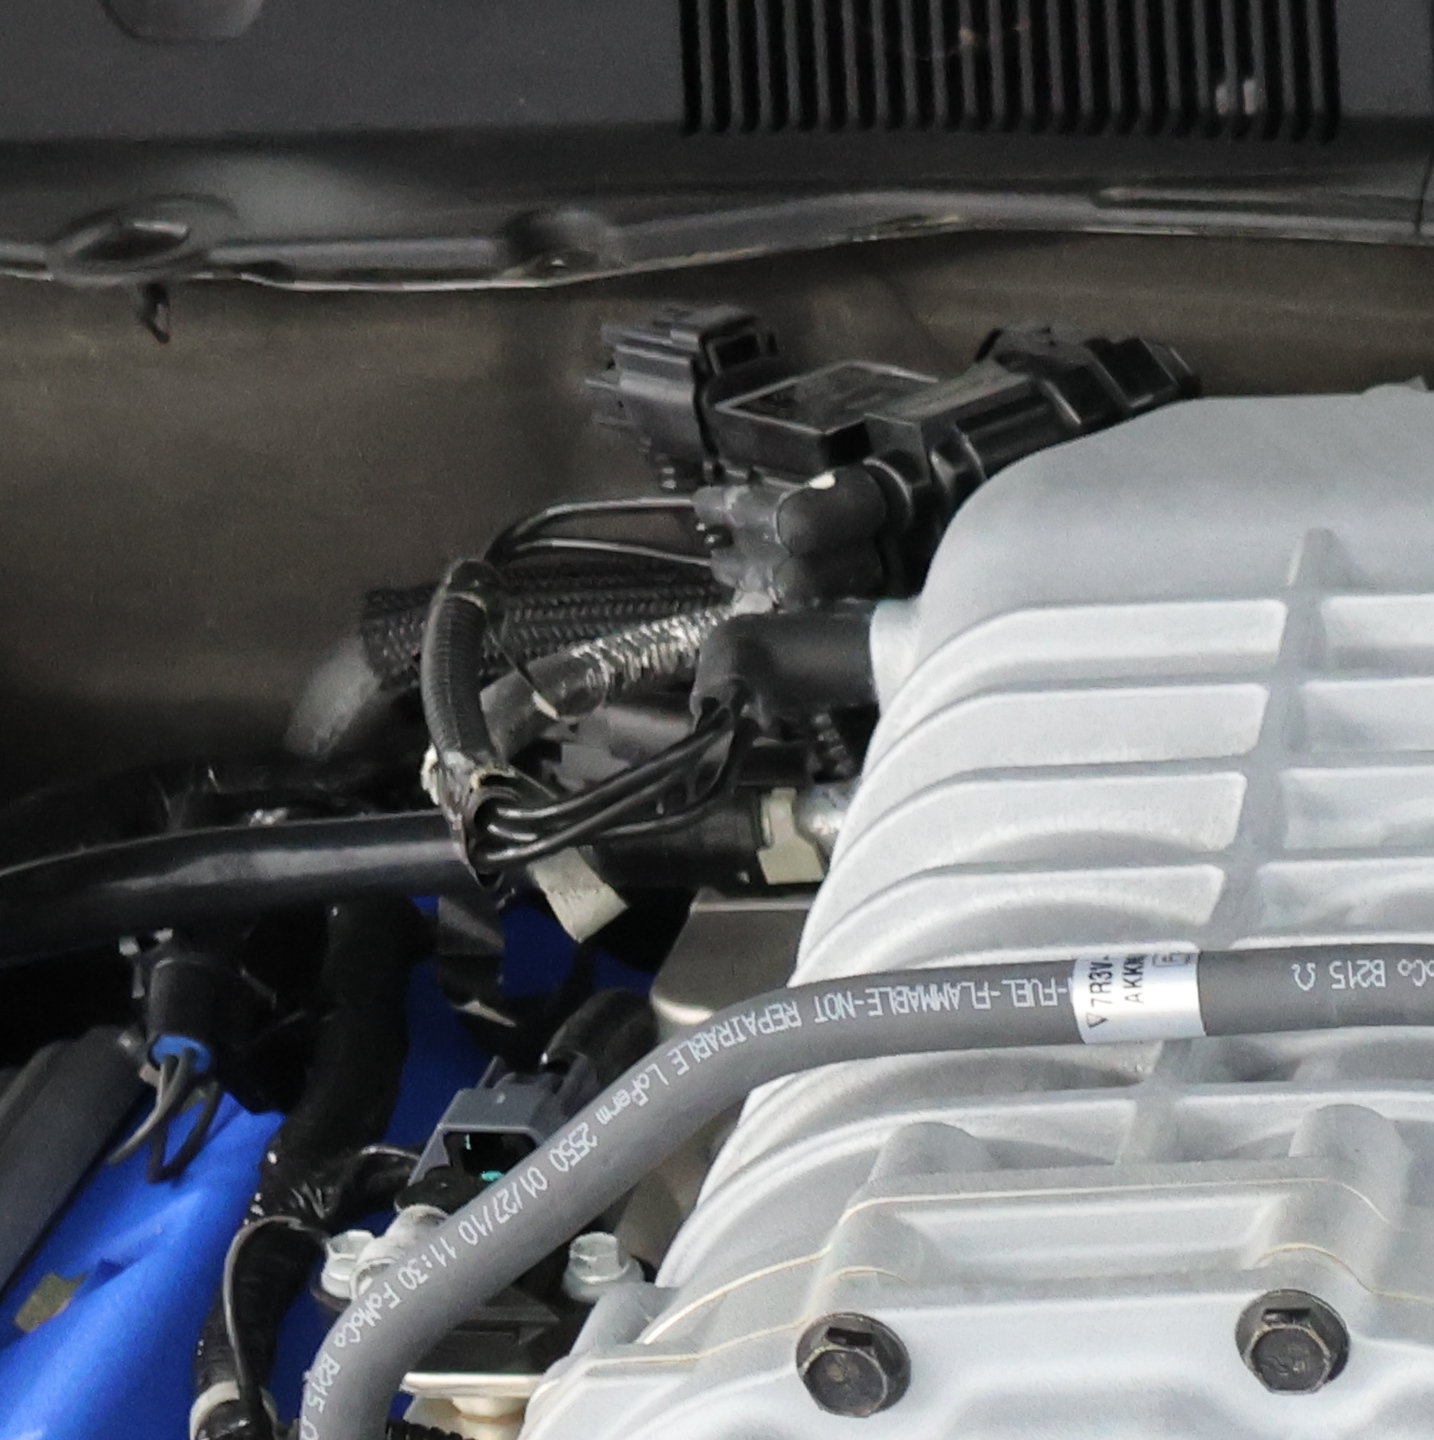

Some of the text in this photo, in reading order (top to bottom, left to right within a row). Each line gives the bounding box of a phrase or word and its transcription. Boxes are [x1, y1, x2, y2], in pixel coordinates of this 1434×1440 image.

[1329, 960, 1386, 990] B215
[667, 1000, 802, 1076] REPAIRABLE
[550, 1122, 598, 1172] 2550
[457, 1165, 548, 1246] 01/27/10
[399, 1236, 458, 1290] 11:30
[334, 1288, 401, 1347] FoMoCo
